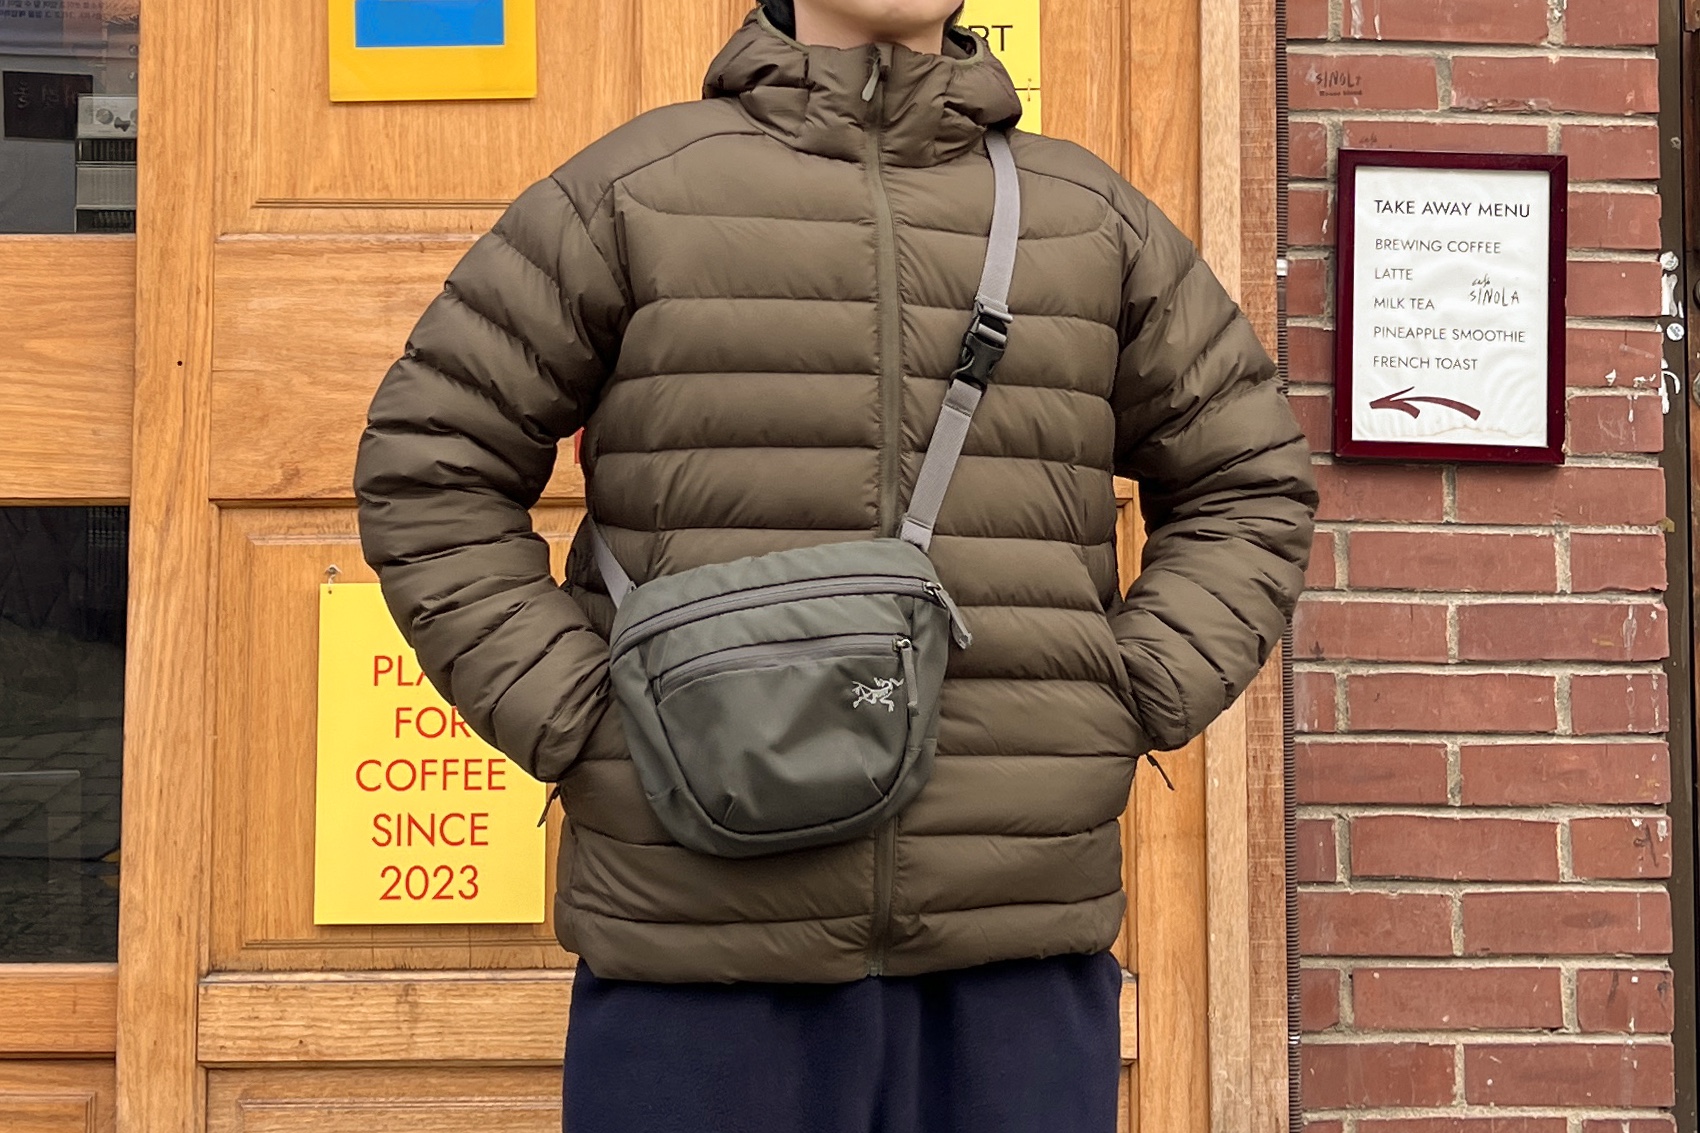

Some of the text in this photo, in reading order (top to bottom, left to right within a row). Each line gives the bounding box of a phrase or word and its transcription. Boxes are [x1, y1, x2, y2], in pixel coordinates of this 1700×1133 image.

[1374, 200, 1530, 218] TAKE AWAY MENU
[1375, 238, 1501, 253] BREWING COFFEE
[1374, 268, 1413, 280] LATTE
[1373, 297, 1435, 310] MILK TEA
[1470, 286, 1519, 306] SINOLA
[1373, 326, 1526, 343] PINEAPPLE SMOOTHIE
[1373, 355, 1478, 370] FRENCH TOAST
[395, 706, 472, 738] FOR
[355, 758, 507, 792] COFFEE
[371, 812, 489, 847] SINCE
[379, 864, 479, 900] 2023
